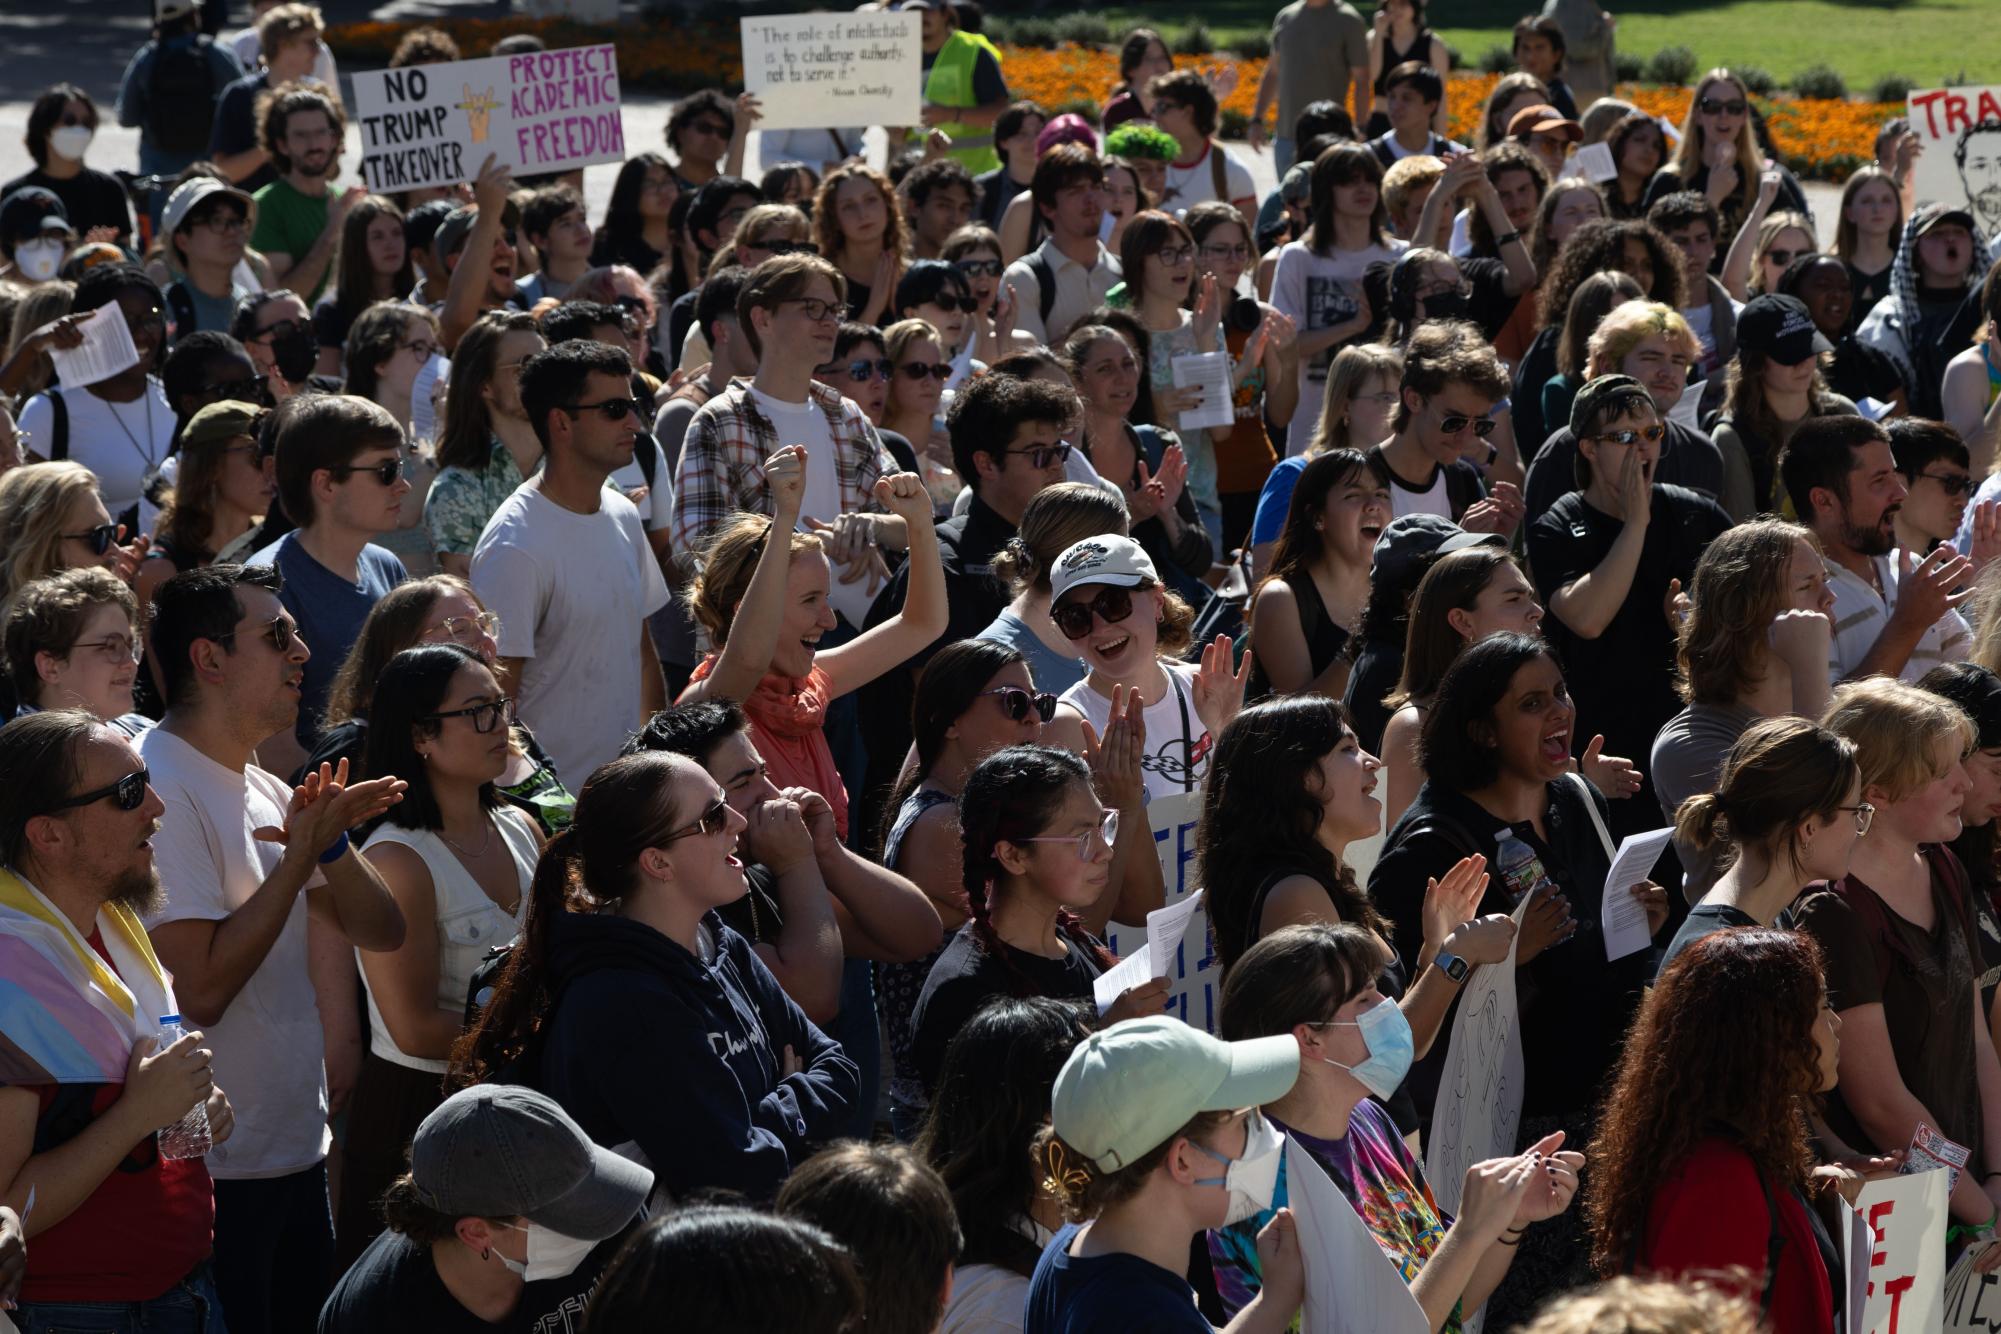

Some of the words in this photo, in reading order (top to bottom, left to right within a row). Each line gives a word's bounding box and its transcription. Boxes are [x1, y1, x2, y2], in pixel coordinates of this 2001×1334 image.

[797, 26, 823, 42] role
[828, 23, 841, 40] of
[847, 20, 909, 39] intellectuals
[510, 47, 614, 84] PROTECT
[765, 52, 776, 65] is
[783, 47, 797, 64] to
[802, 44, 854, 65] challenge
[383, 69, 427, 103] NO
[766, 63, 785, 83] not
[790, 63, 802, 82] to
[804, 69, 835, 82] serve
[511, 74, 616, 119] ACADEMIC
[362, 105, 448, 146] TRUMP
[516, 110, 625, 165] FREEDOM
[366, 142, 464, 189] TAKEOVER
[1061, 543, 1108, 567] CHICAGO
